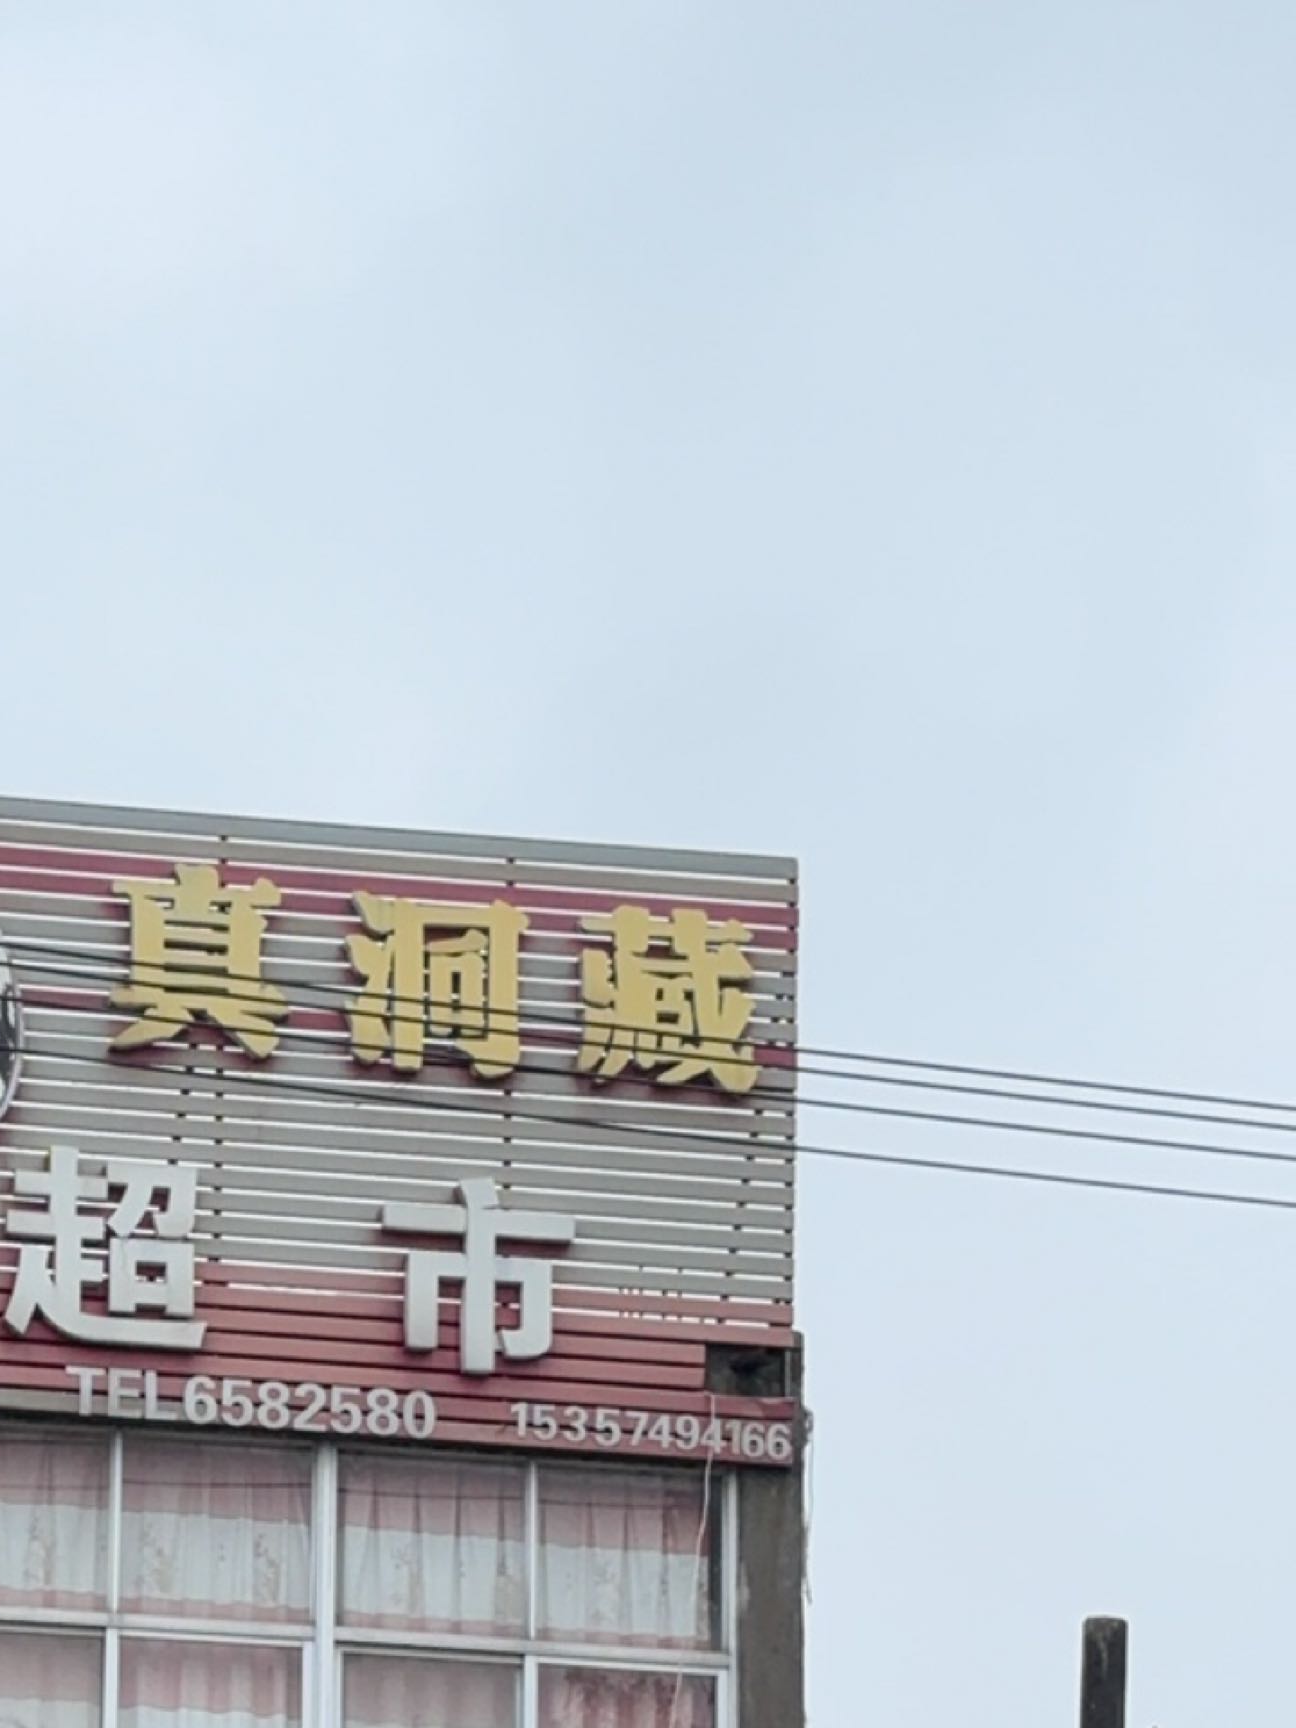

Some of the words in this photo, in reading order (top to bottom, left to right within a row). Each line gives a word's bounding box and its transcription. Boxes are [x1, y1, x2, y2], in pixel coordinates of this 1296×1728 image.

[107, 862, 763, 1094] 真洞藏
[509, 1400, 794, 1463] 15357494166
